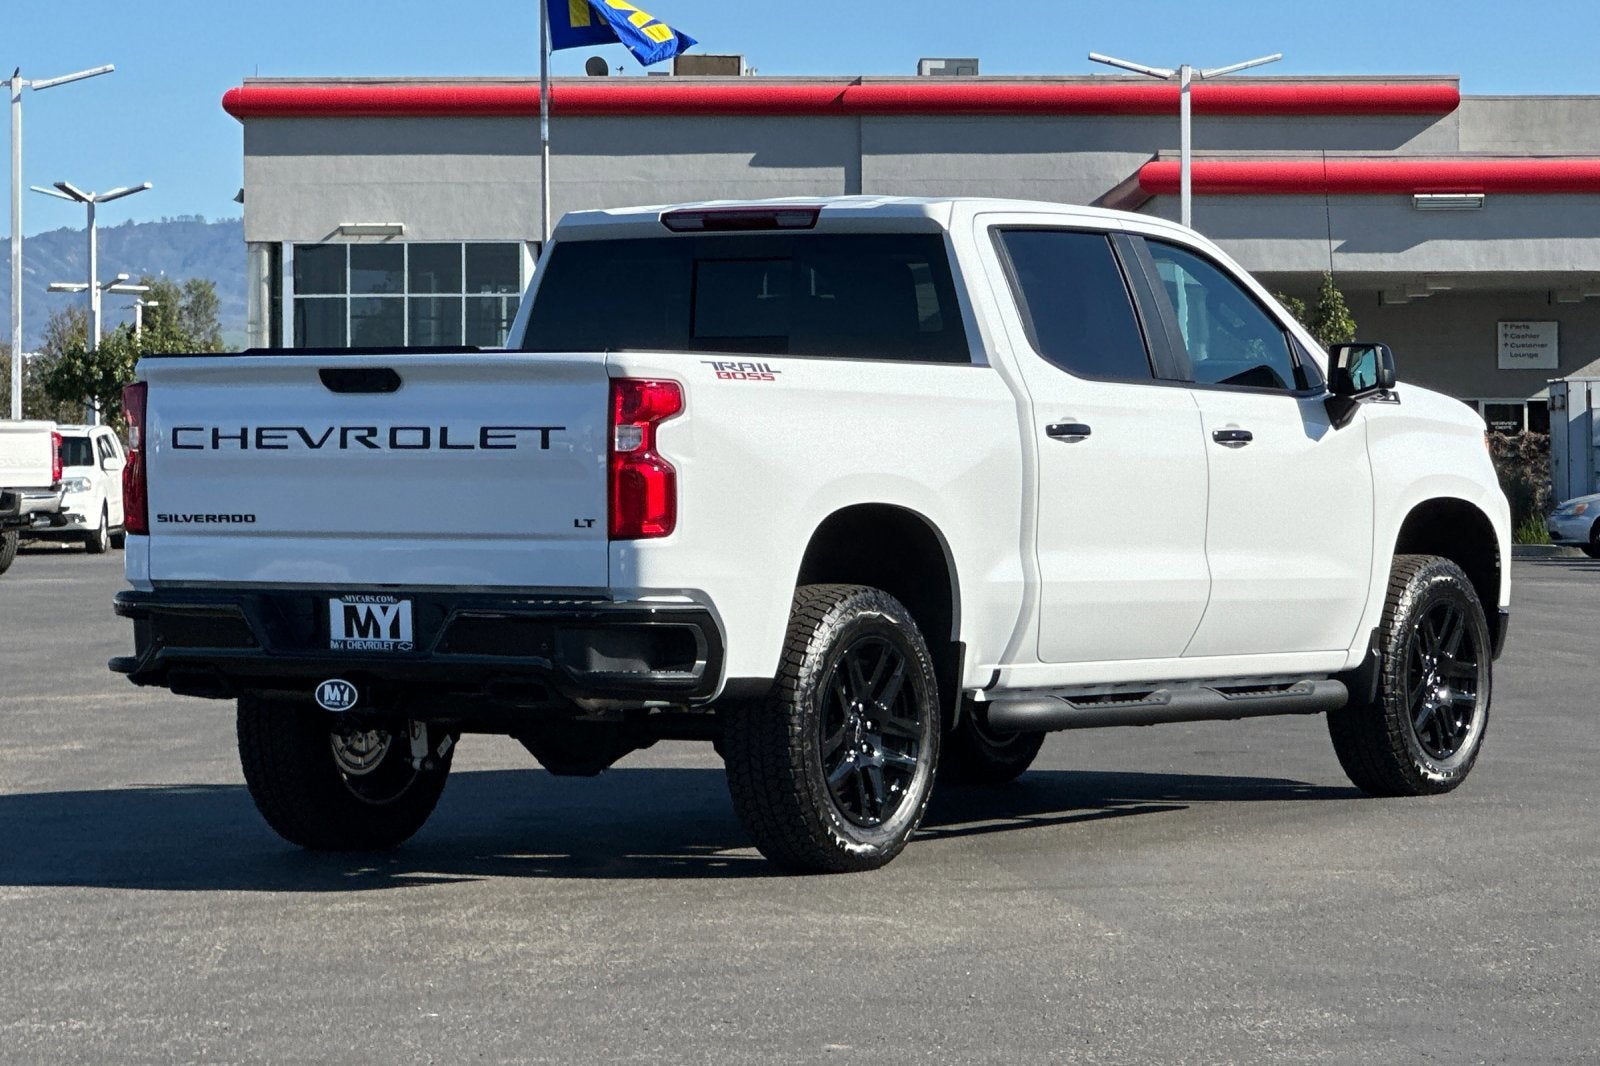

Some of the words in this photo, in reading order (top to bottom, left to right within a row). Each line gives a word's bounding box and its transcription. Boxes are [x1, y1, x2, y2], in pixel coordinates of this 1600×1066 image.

[1510, 351, 1539, 360] Lounge
[700, 360, 782, 374] TRAIL
[715, 371, 776, 382] BOSS
[171, 426, 567, 450] CHEVROLET
[156, 513, 257, 524] SILVERADO
[573, 518, 596, 528] LT
[343, 594, 395, 603] MYCARS.COM
[343, 604, 401, 640] MY
[346, 640, 395, 651] CHEVROLET
[323, 684, 350, 702] MY
